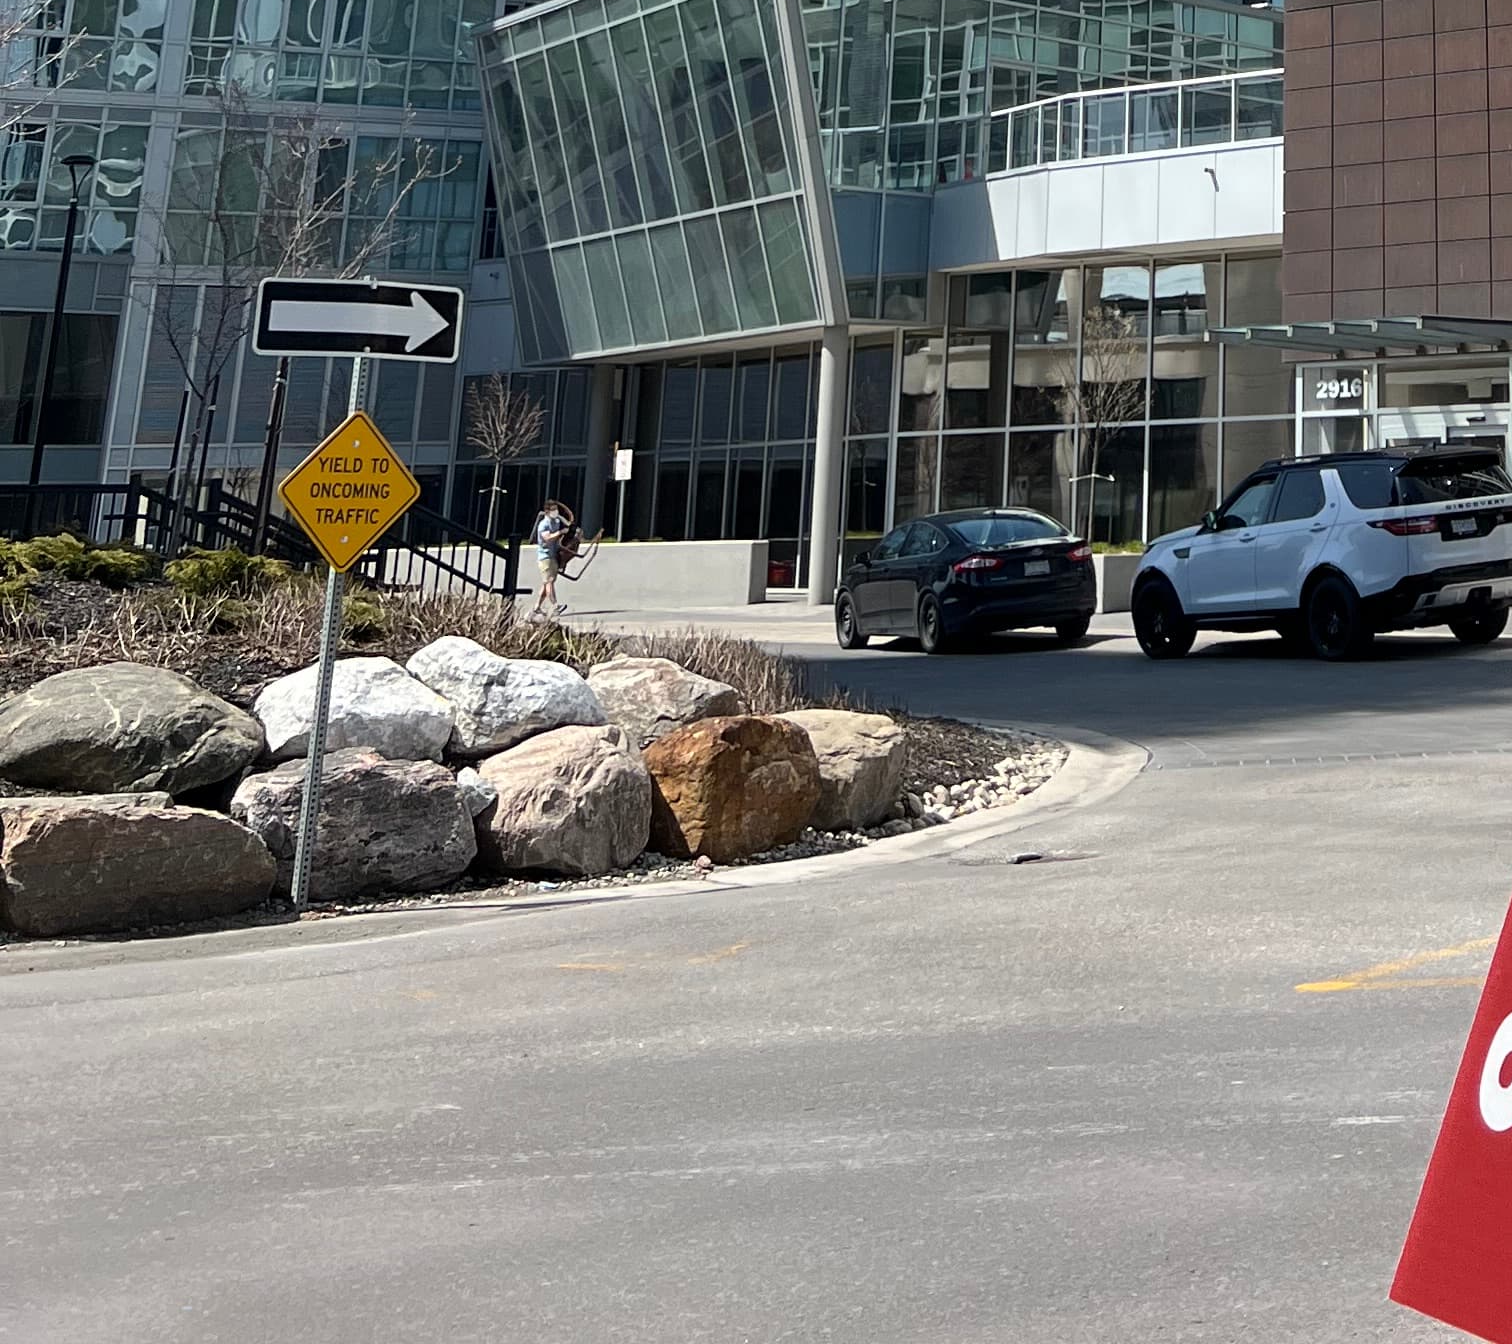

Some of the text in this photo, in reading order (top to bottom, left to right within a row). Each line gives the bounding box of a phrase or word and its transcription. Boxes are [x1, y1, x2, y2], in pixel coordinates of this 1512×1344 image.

[1316, 377, 1362, 399] 2916
[319, 457, 390, 473] YIELD TO
[310, 482, 390, 499] ONCOMING
[315, 508, 380, 524] TRAFFIC
